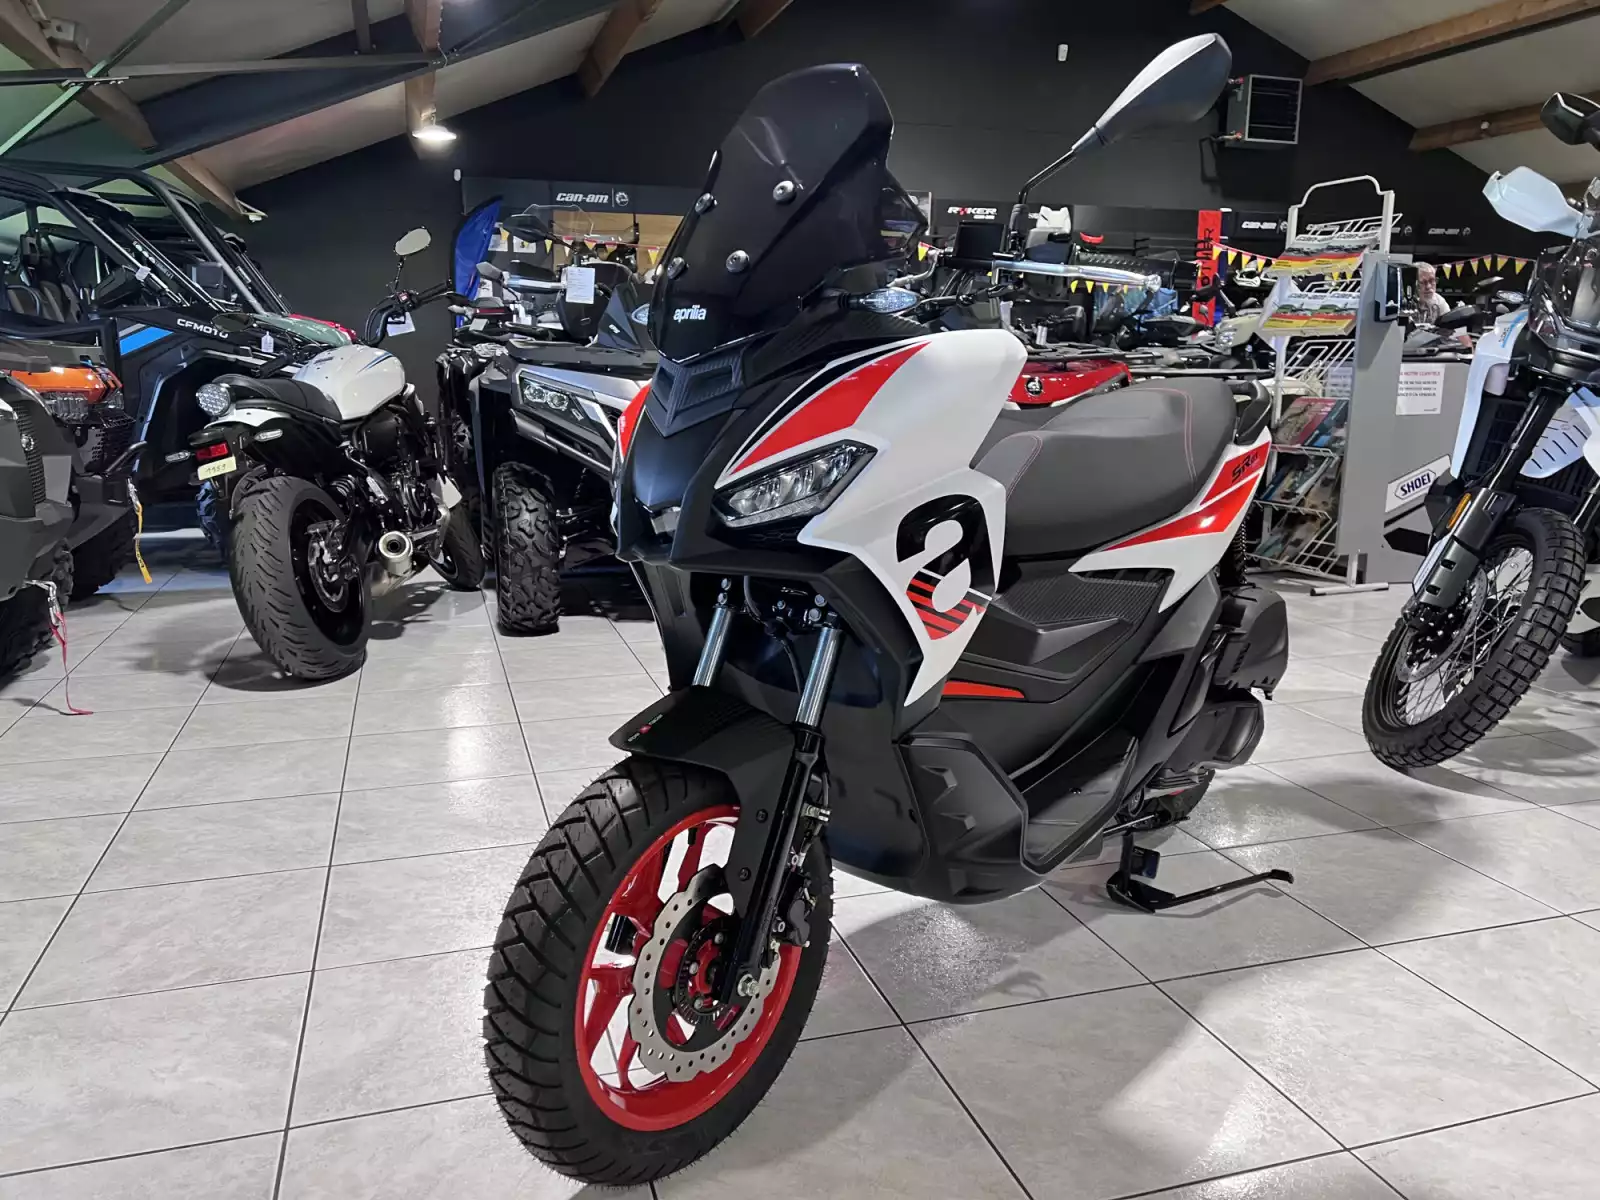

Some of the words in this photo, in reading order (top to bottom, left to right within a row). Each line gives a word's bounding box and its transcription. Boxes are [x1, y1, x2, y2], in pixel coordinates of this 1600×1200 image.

[556, 192, 609, 204] can-am
[673, 304, 707, 323] aprilia
[1400, 472, 1431, 497] SHOEI
